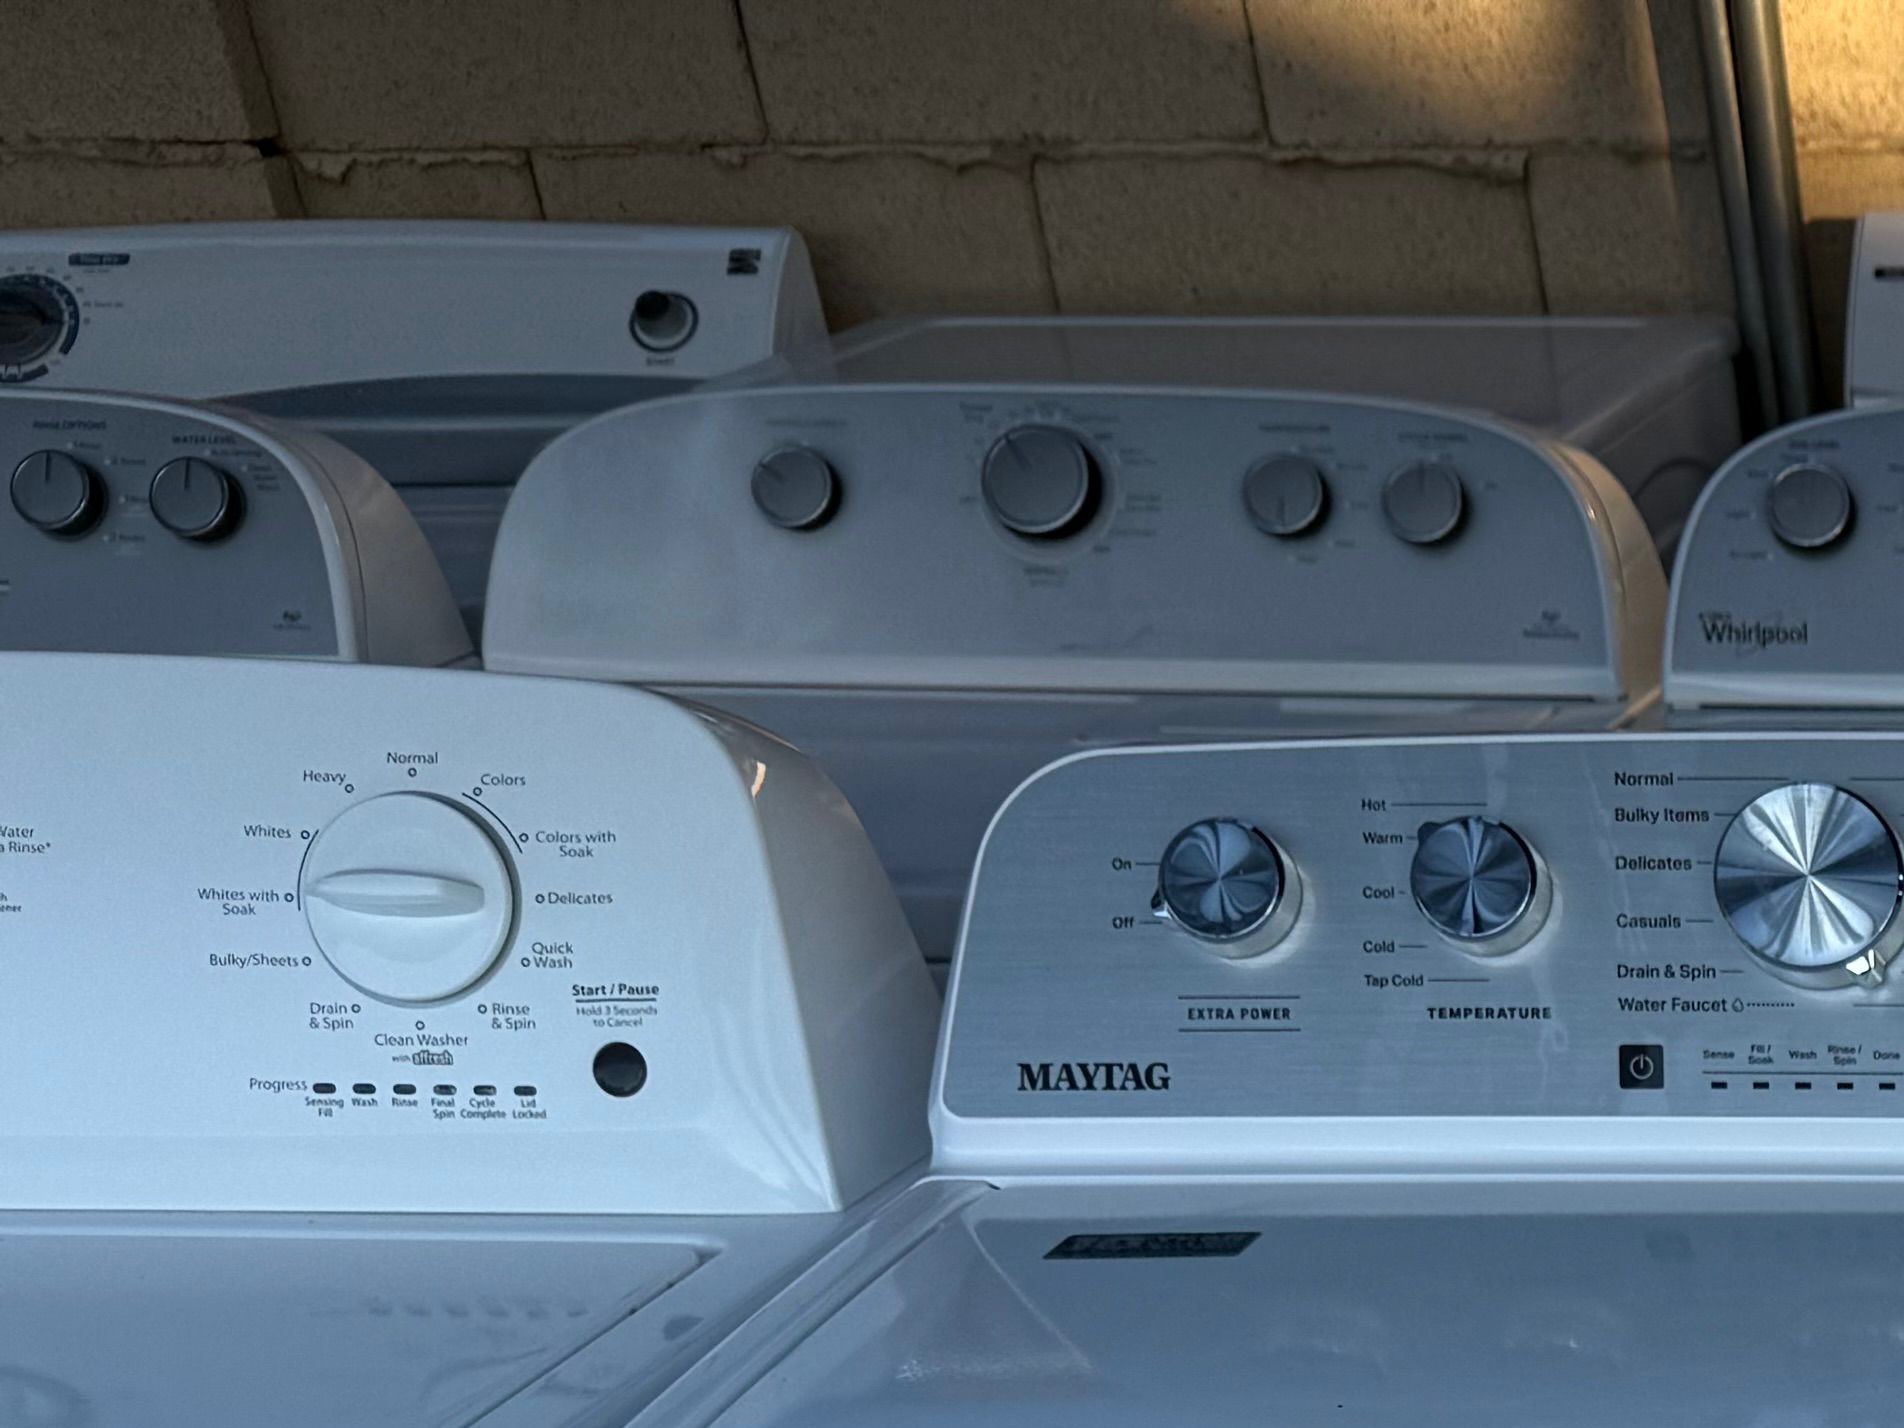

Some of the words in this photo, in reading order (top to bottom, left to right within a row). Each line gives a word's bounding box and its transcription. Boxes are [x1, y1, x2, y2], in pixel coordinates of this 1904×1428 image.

[1699, 616, 1807, 648] Whirlpool
[387, 752, 438, 764] Normal
[304, 770, 346, 785] Heavy
[481, 774, 525, 786] Colors
[1615, 772, 1673, 786] Normal
[1362, 799, 1386, 811] Hot
[1615, 808, 1659, 824] Bulky
[1664, 808, 1709, 822] Items
[244, 825, 291, 838] Whites
[536, 831, 581, 843] Colors
[585, 831, 616, 843] with
[1363, 832, 1403, 844] Warm
[559, 845, 593, 857] Soak
[1112, 858, 1131, 870] On
[1615, 856, 1692, 870] Delicates
[198, 888, 245, 900] Whites
[249, 890, 279, 902] with
[548, 892, 613, 904] Delicates
[1363, 886, 1394, 899] Cool
[223, 903, 256, 915] Soak
[1112, 917, 1134, 929] Off
[1616, 914, 1681, 928] Casuals
[532, 942, 573, 955] Quick
[1363, 941, 1395, 953] Cold
[210, 954, 298, 968] Bulky/Sheets
[534, 956, 572, 968] Wash
[1617, 964, 1659, 978] Drain
[1664, 964, 1675, 978] &
[1680, 964, 1716, 981] Spin
[1364, 975, 1388, 988] Tap
[1392, 974, 1423, 987] Cold
[572, 984, 606, 996] Start
[618, 983, 659, 995] Pause
[310, 1002, 347, 1014] Drain
[492, 1003, 530, 1015] Rinse
[1618, 998, 1666, 1012] Water
[1672, 997, 1727, 1012] Faucet
[1188, 1008, 1234, 1020] EXTRA
[1241, 1008, 1290, 1020] POWER
[1427, 1008, 1550, 1019] TEMPERATURE
[309, 1017, 320, 1029] &
[323, 1017, 353, 1031] Spin
[492, 1017, 501, 1029] &
[505, 1017, 536, 1031] Spin
[374, 1034, 414, 1046] Clean
[417, 1034, 467, 1046] Washer
[1017, 1063, 1170, 1090] MAYTAG
[250, 1078, 307, 1093] Progress
[352, 1098, 377, 1106] Wash
[392, 1097, 418, 1106] Rinse
[512, 1110, 546, 1119] Locked
